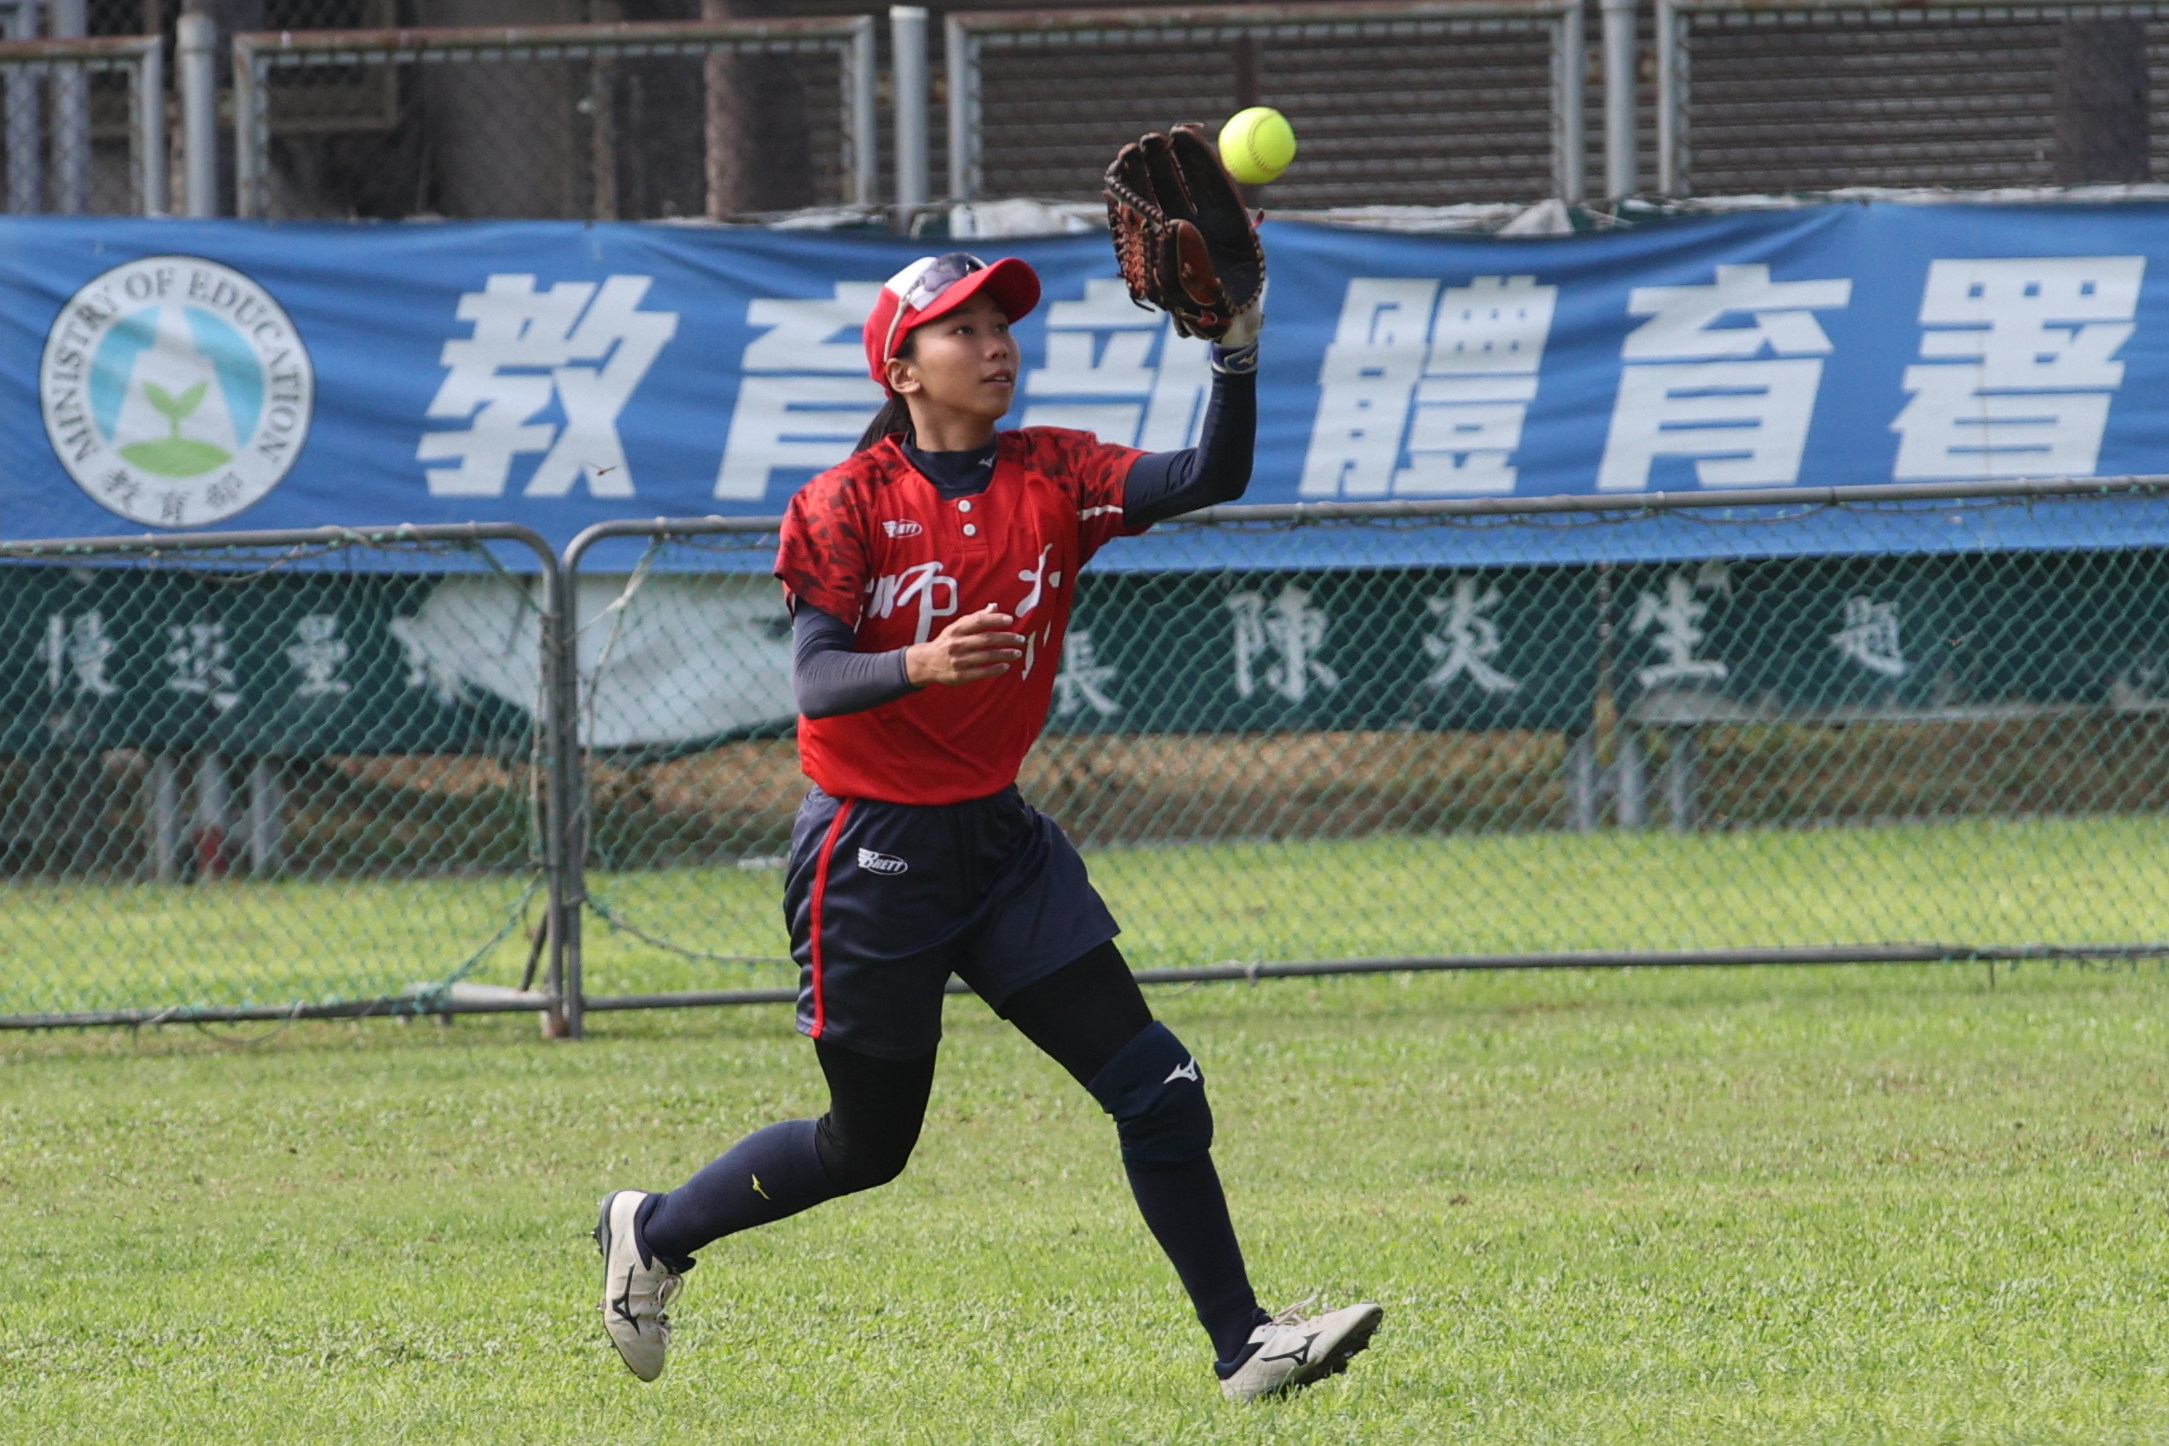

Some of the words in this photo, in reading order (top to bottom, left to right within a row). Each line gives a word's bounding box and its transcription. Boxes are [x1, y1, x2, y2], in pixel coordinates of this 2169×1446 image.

[52, 285, 119, 463] MINISTRY
[125, 266, 176, 299] OF
[187, 268, 299, 464] EDUCATION
[415, 254, 2147, 500] 教育部體育署
